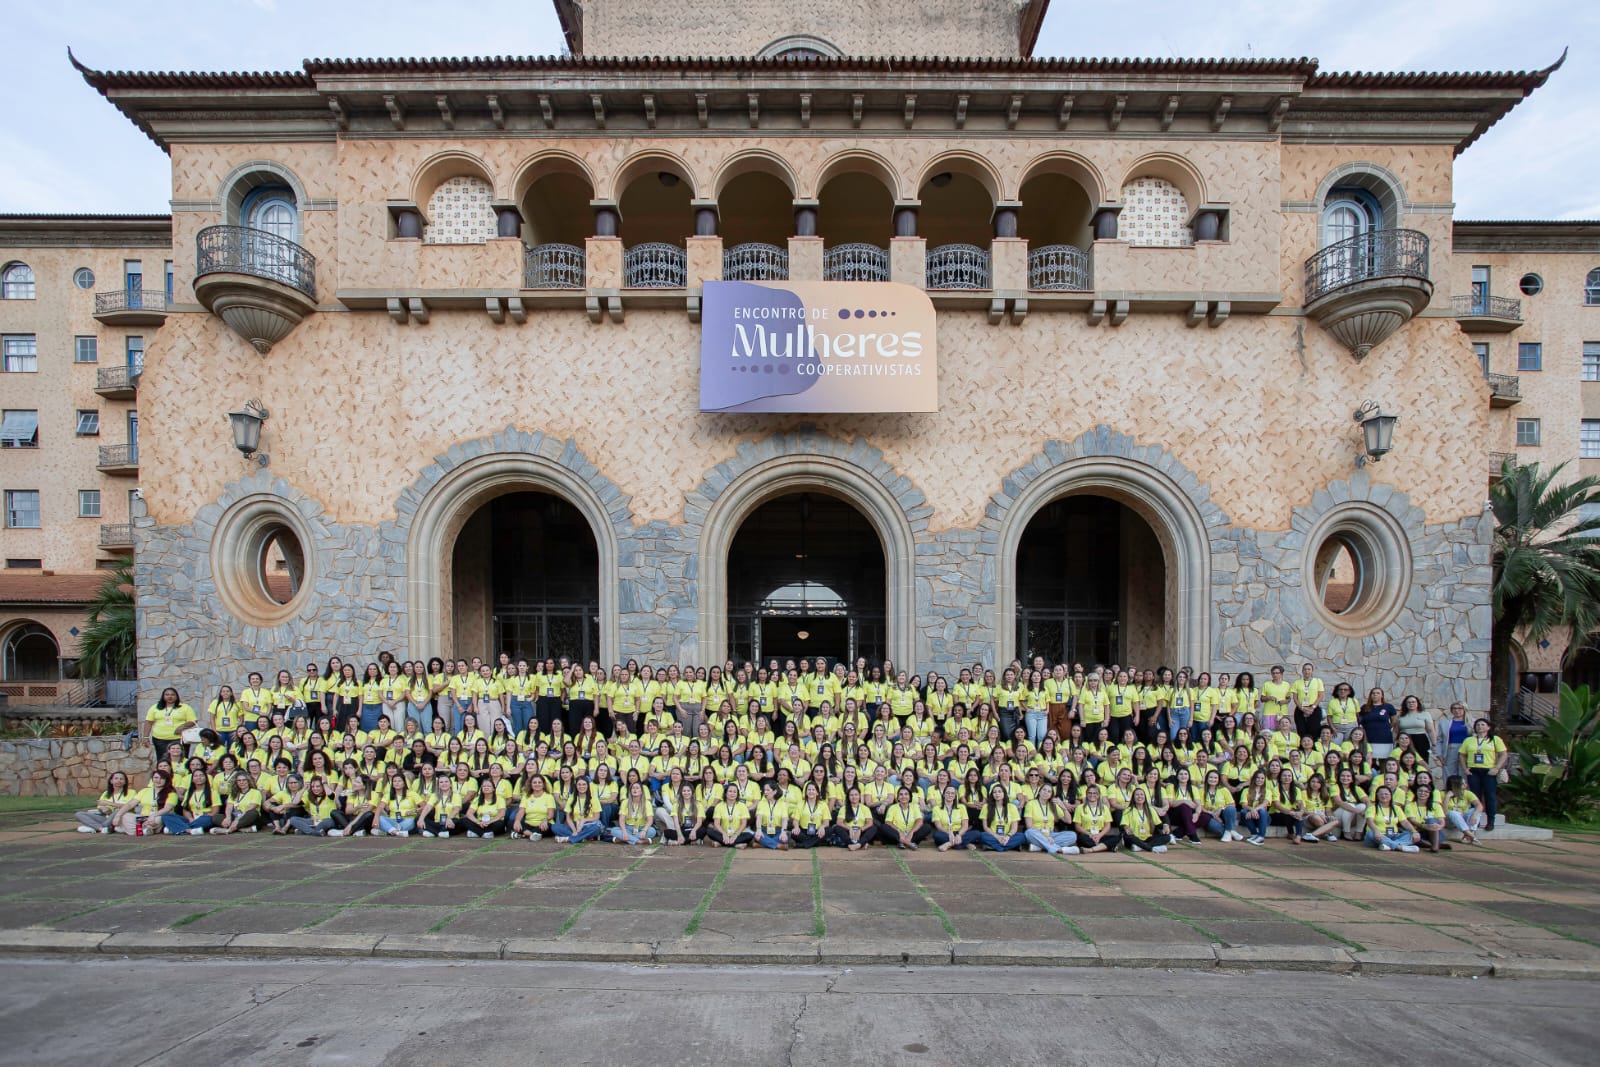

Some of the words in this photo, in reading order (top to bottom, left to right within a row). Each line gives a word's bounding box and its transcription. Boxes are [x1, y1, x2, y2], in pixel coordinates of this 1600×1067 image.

[734, 307, 807, 320] ENCONTRO
[812, 307, 829, 320] DE
[731, 323, 922, 358] Mulheres
[796, 363, 922, 376] COOPERATIVISTAS
